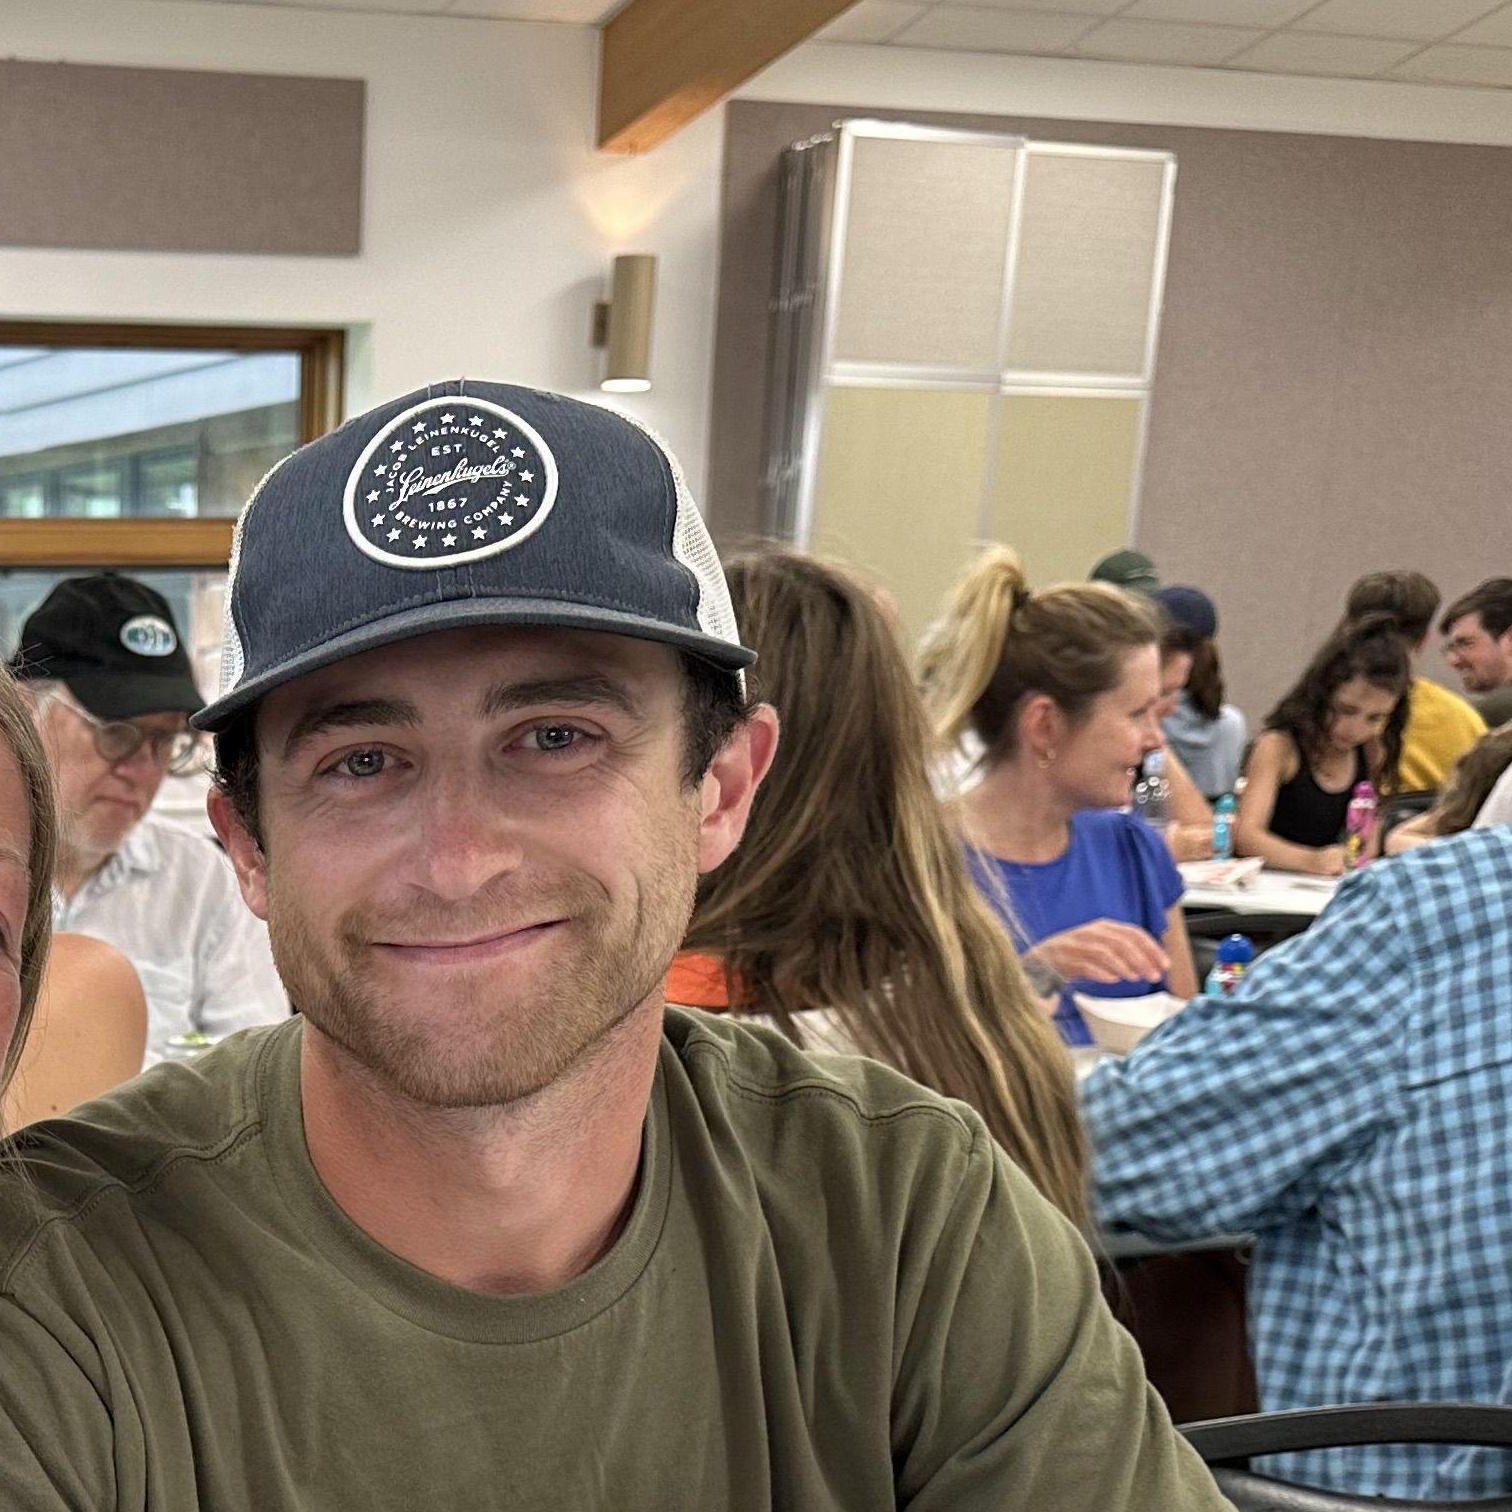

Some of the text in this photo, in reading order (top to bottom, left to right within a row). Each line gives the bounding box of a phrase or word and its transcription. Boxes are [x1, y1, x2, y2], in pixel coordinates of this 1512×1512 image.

[386, 426, 501, 493] JACOB LEINENKUGEL
[394, 480, 513, 530] BREWING COMPANY
[428, 497, 468, 513] 1867
